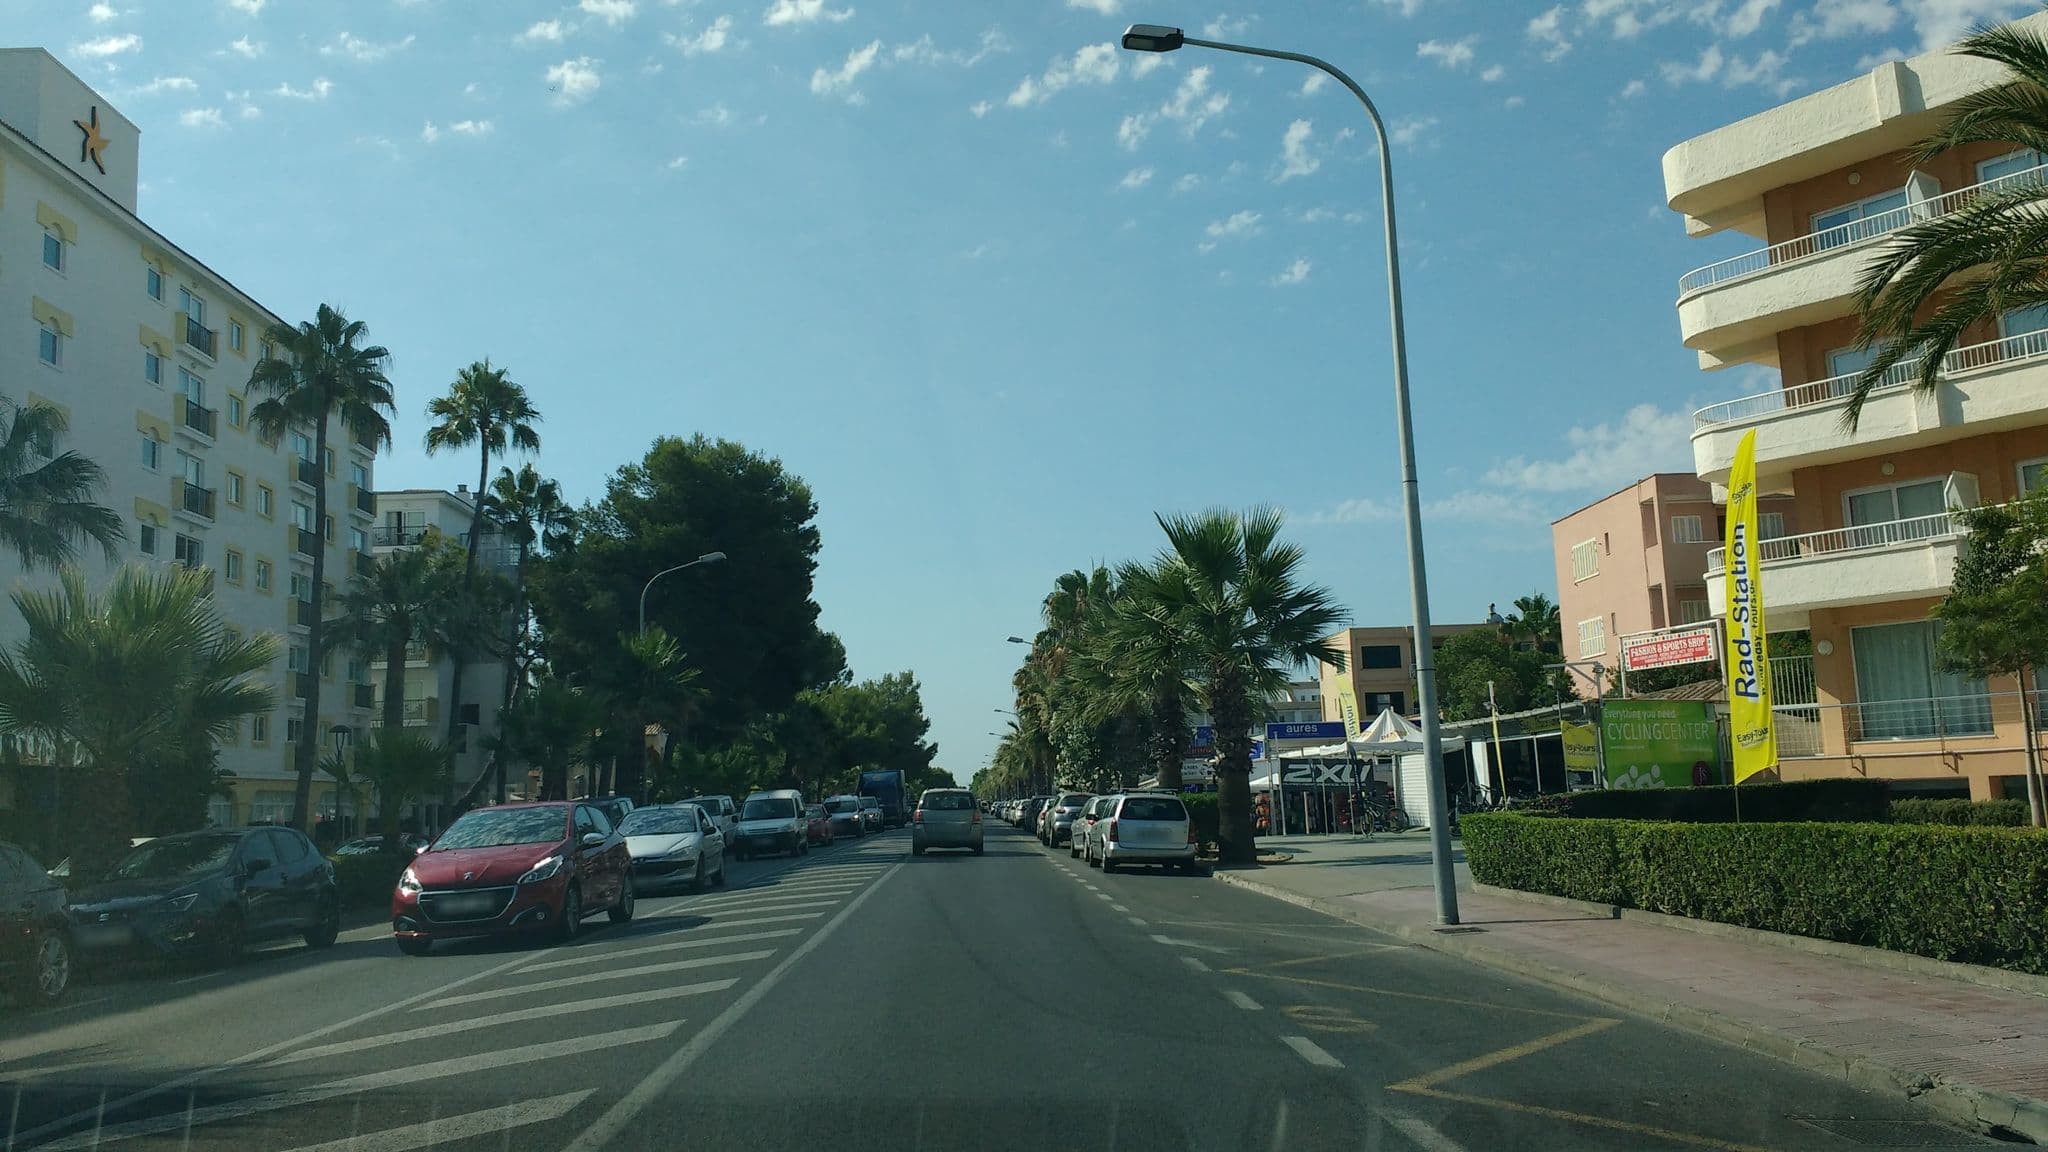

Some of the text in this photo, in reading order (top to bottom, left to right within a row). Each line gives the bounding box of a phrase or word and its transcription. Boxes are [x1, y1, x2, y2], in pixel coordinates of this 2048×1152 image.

[1731, 524, 1759, 698] Rad-Station
[1630, 644, 1657, 657] FASHION
[1662, 639, 1688, 652] SPORTS
[1688, 637, 1706, 647] SHOP
[1642, 711, 1656, 720] you
[1286, 724, 1318, 733] aures
